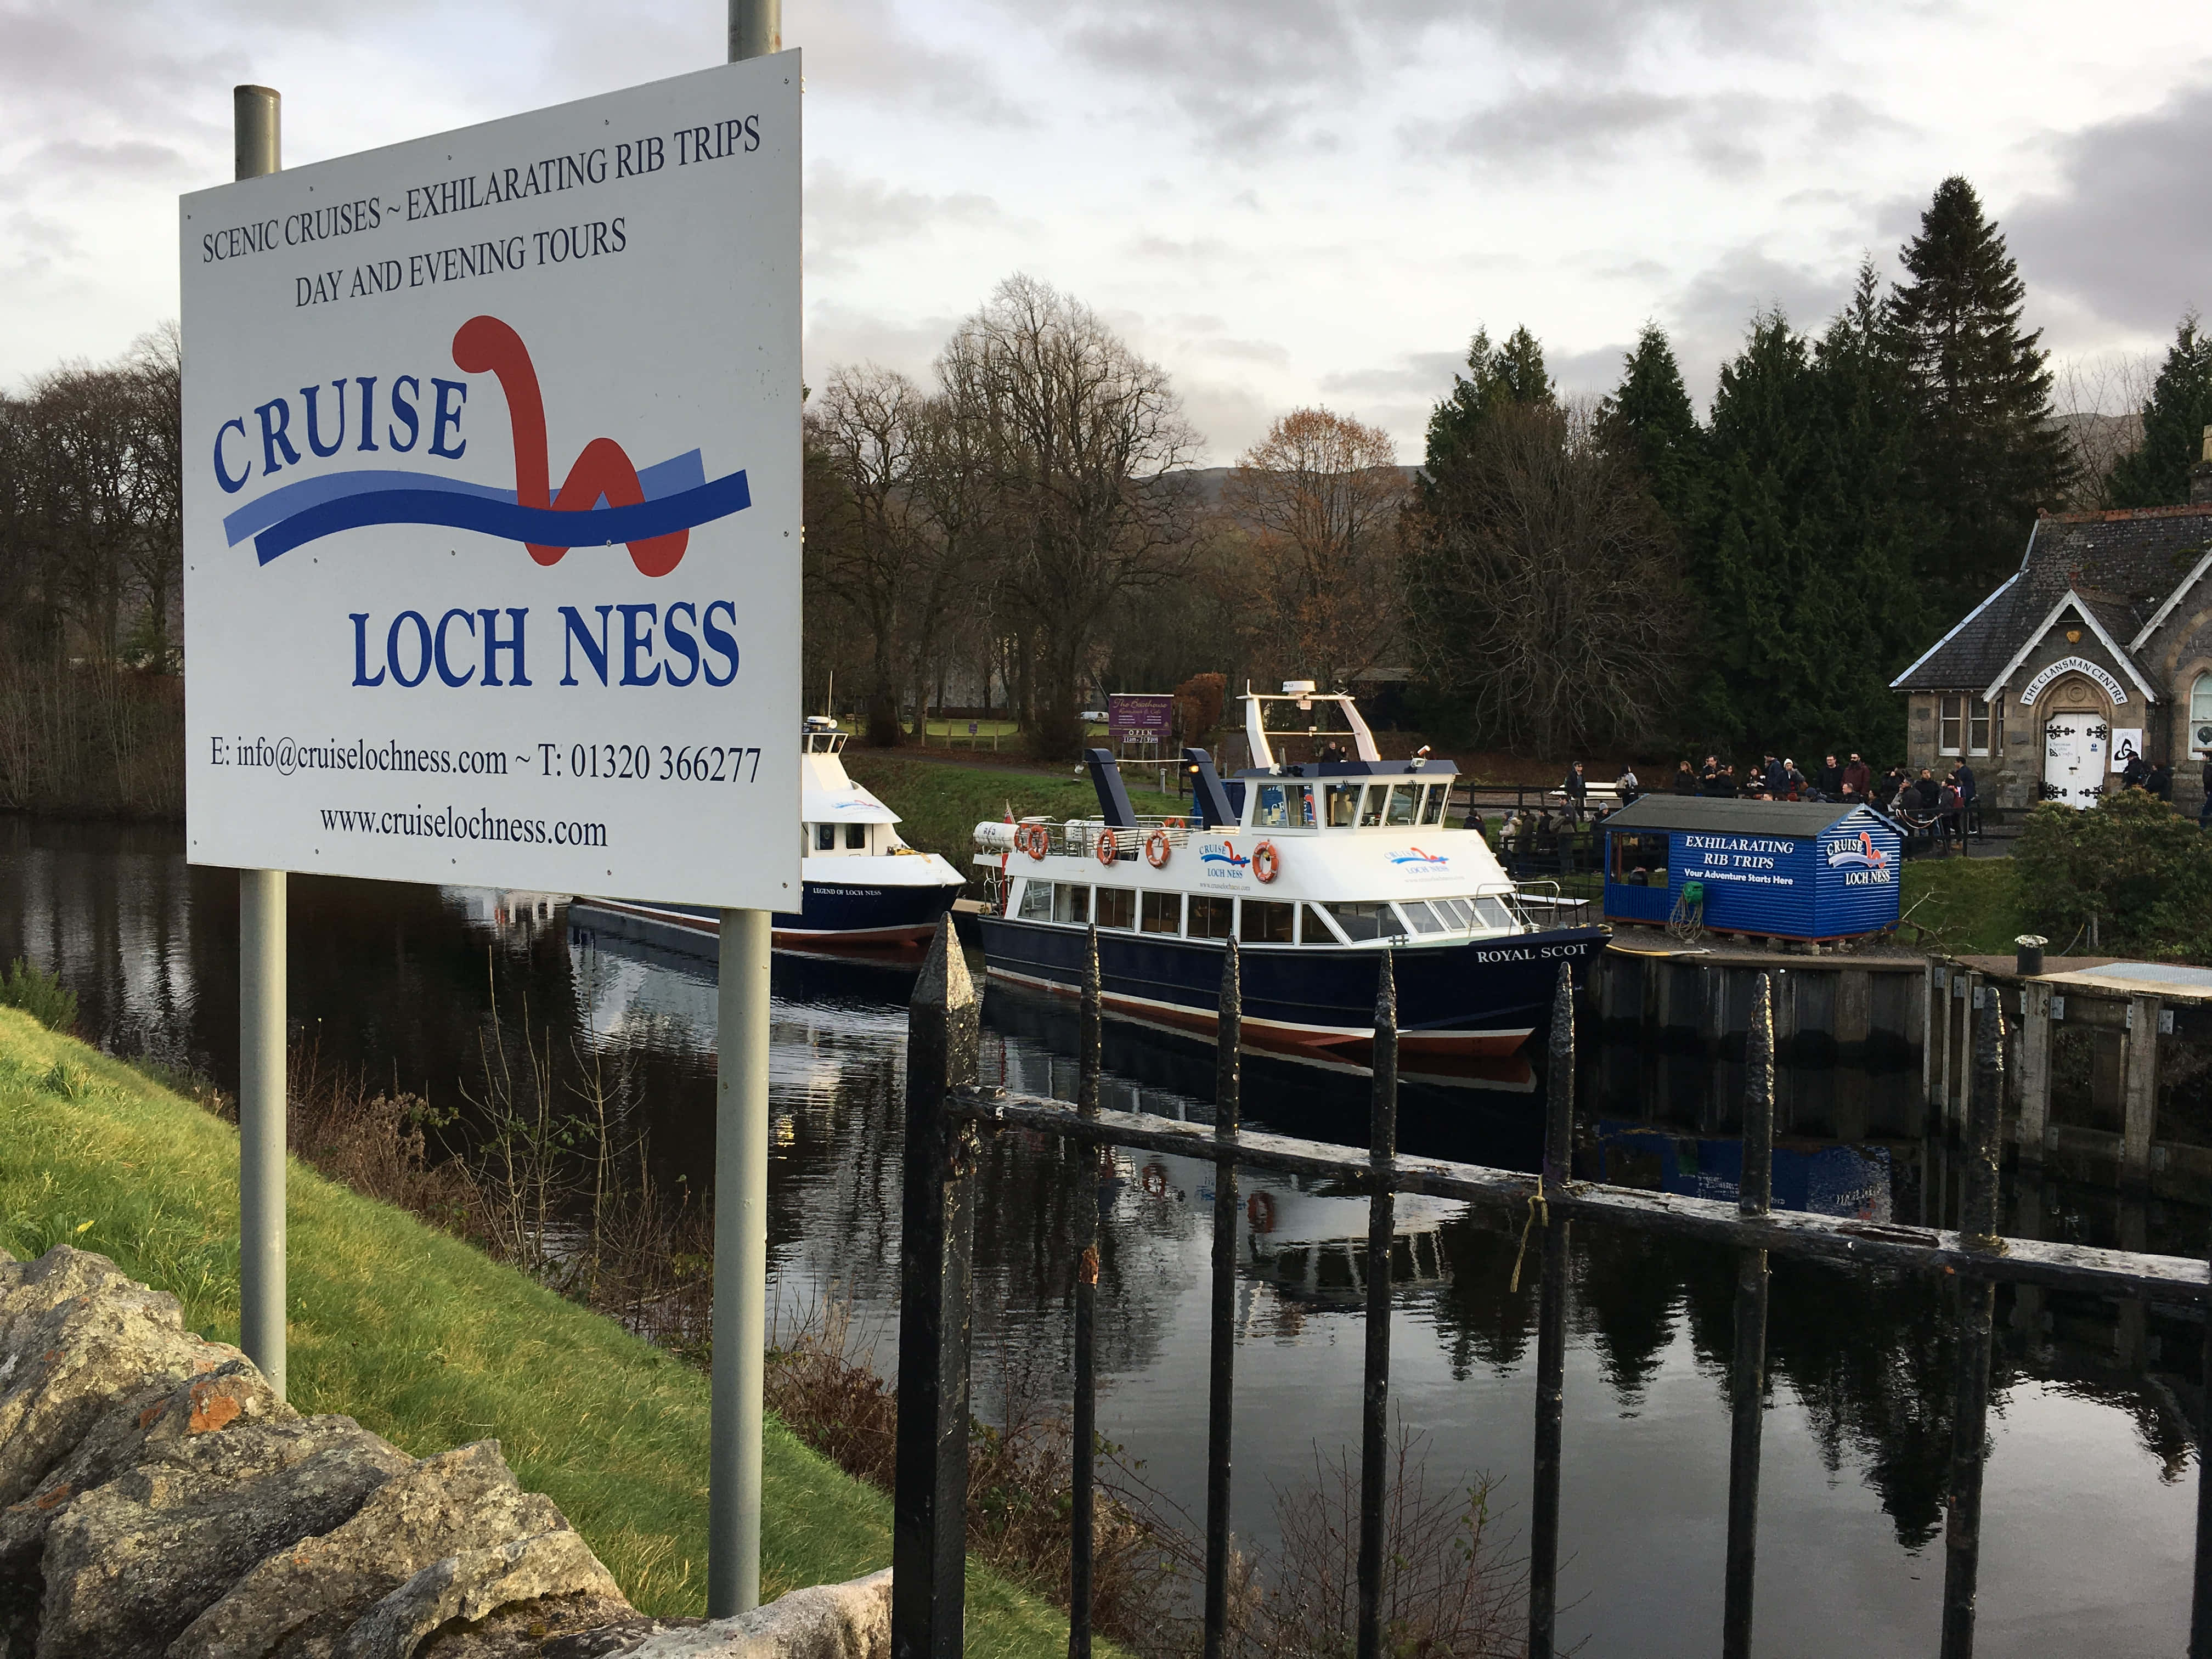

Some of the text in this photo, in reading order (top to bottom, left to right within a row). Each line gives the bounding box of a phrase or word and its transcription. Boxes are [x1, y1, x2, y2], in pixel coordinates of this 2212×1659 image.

[203, 218, 279, 264] SCENIC
[285, 196, 381, 246] CRUISES
[405, 147, 608, 222] EXHILARATING
[614, 137, 665, 179] RIB
[674, 114, 760, 166] TRIPS
[295, 216, 627, 307] DAY AND EVENING TOURS
[213, 375, 467, 494] CRUISE
[348, 600, 740, 688] LOCH NESS
[2023, 659, 2125, 703] THE CLANSMAN CENTRE
[1113, 698, 1168, 709] The Boathouse
[210, 736, 230, 766] E:
[236, 737, 508, 776] info@cruiselochness.com
[538, 743, 562, 778] T:
[571, 743, 650, 780] 01320
[659, 746, 761, 783] 366277
[320, 804, 608, 847] www.cruiselochness.com
[1199, 844, 1226, 855] CRUISE
[1685, 835, 1794, 854] EXHILARATING
[1827, 838, 1863, 856] CRUISE
[1384, 851, 1418, 859] CRUISE
[1703, 853, 1774, 869] RIB TRIPS
[1207, 868, 1243, 879] LOCH NESS
[1405, 866, 1429, 874] LOCH
[1684, 868, 1793, 885] Your Adventure Starts Here
[1845, 870, 1891, 885] LOCH NESS
[1475, 944, 1588, 963] ROYAL SCOT
